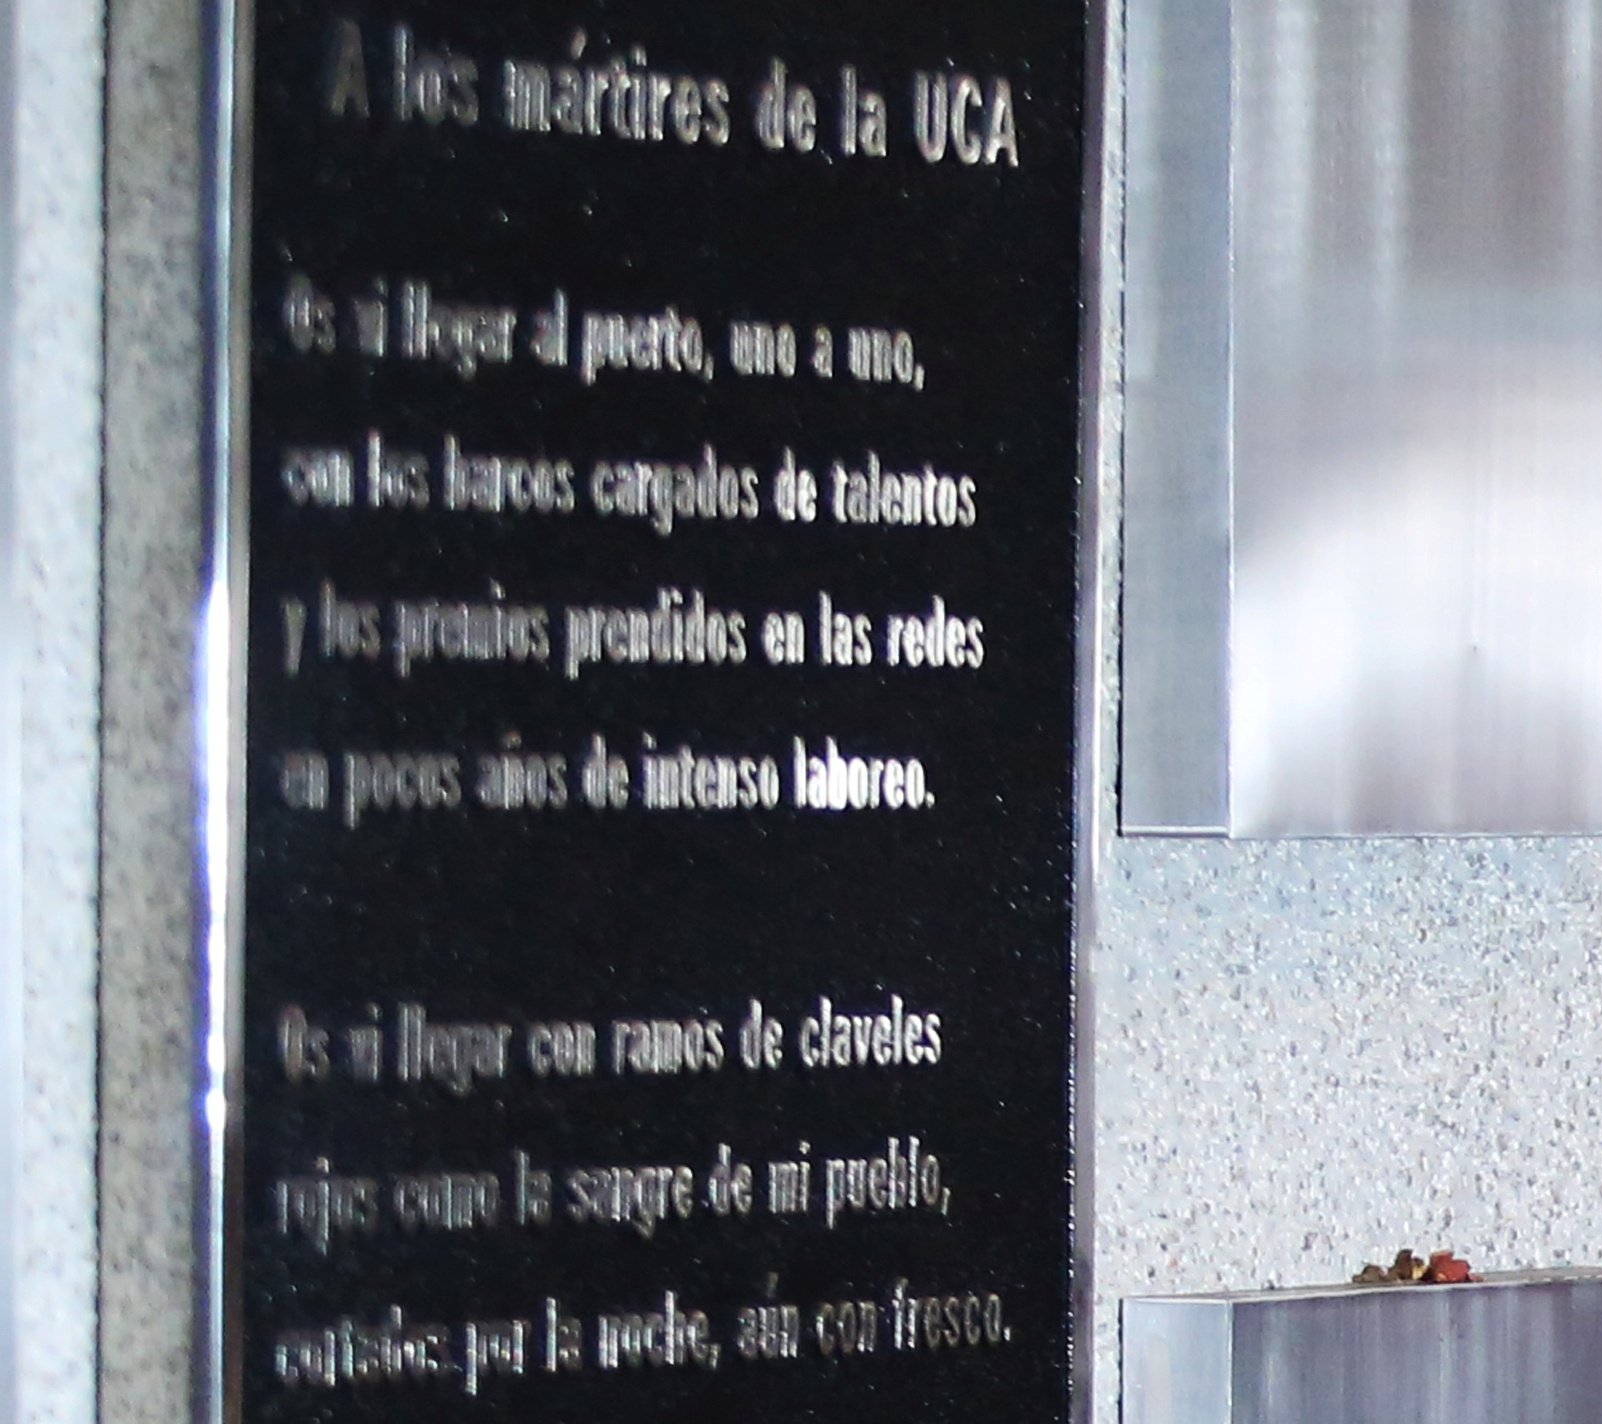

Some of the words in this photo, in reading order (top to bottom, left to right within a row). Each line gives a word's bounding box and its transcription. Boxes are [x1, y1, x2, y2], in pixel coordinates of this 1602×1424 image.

[328, 19, 369, 119] A
[395, 26, 479, 126] los
[503, 27, 731, 147] mártires
[756, 57, 817, 151] de
[840, 64, 887, 158] la
[914, 70, 1020, 168] UCA
[284, 272, 336, 354] Os
[354, 279, 386, 358] vi
[400, 277, 516, 382] llegar
[531, 289, 567, 366] al
[581, 308, 714, 385] puerto,
[729, 321, 797, 378] uno
[813, 326, 833, 378] a
[847, 326, 926, 391] uno,
[282, 448, 351, 508] con
[366, 430, 430, 508] los
[443, 435, 574, 513] barcos
[592, 444, 760, 534] cargados
[773, 447, 817, 524] de
[833, 450, 977, 528] talentos
[282, 602, 306, 676] y
[319, 578, 380, 662] los
[396, 576, 549, 676] premios
[564, 588, 746, 679] prendidos
[761, 610, 805, 662] en
[820, 592, 873, 665] las
[885, 595, 986, 669] redes
[282, 753, 329, 810] en
[346, 749, 462, 828] pocos
[475, 731, 567, 810] años
[582, 734, 629, 810] de
[643, 734, 780, 810] intenso
[793, 736, 936, 810] laboreo.
[278, 1005, 329, 1081] Os
[349, 1004, 381, 1083] vi
[399, 1002, 512, 1097] llegar
[527, 1019, 596, 1076] con
[612, 1017, 724, 1076] ramos
[739, 997, 783, 1071] de
[800, 996, 942, 1068] claveles
[514, 1147, 552, 1226] la
[567, 1160, 694, 1239] sangre
[708, 1144, 752, 1217] de
[768, 1142, 811, 1213] mi
[826, 1135, 951, 1229] pueblo,
[543, 1296, 584, 1376] la
[736, 1273, 798, 1359] aún
[815, 1301, 877, 1355] con
